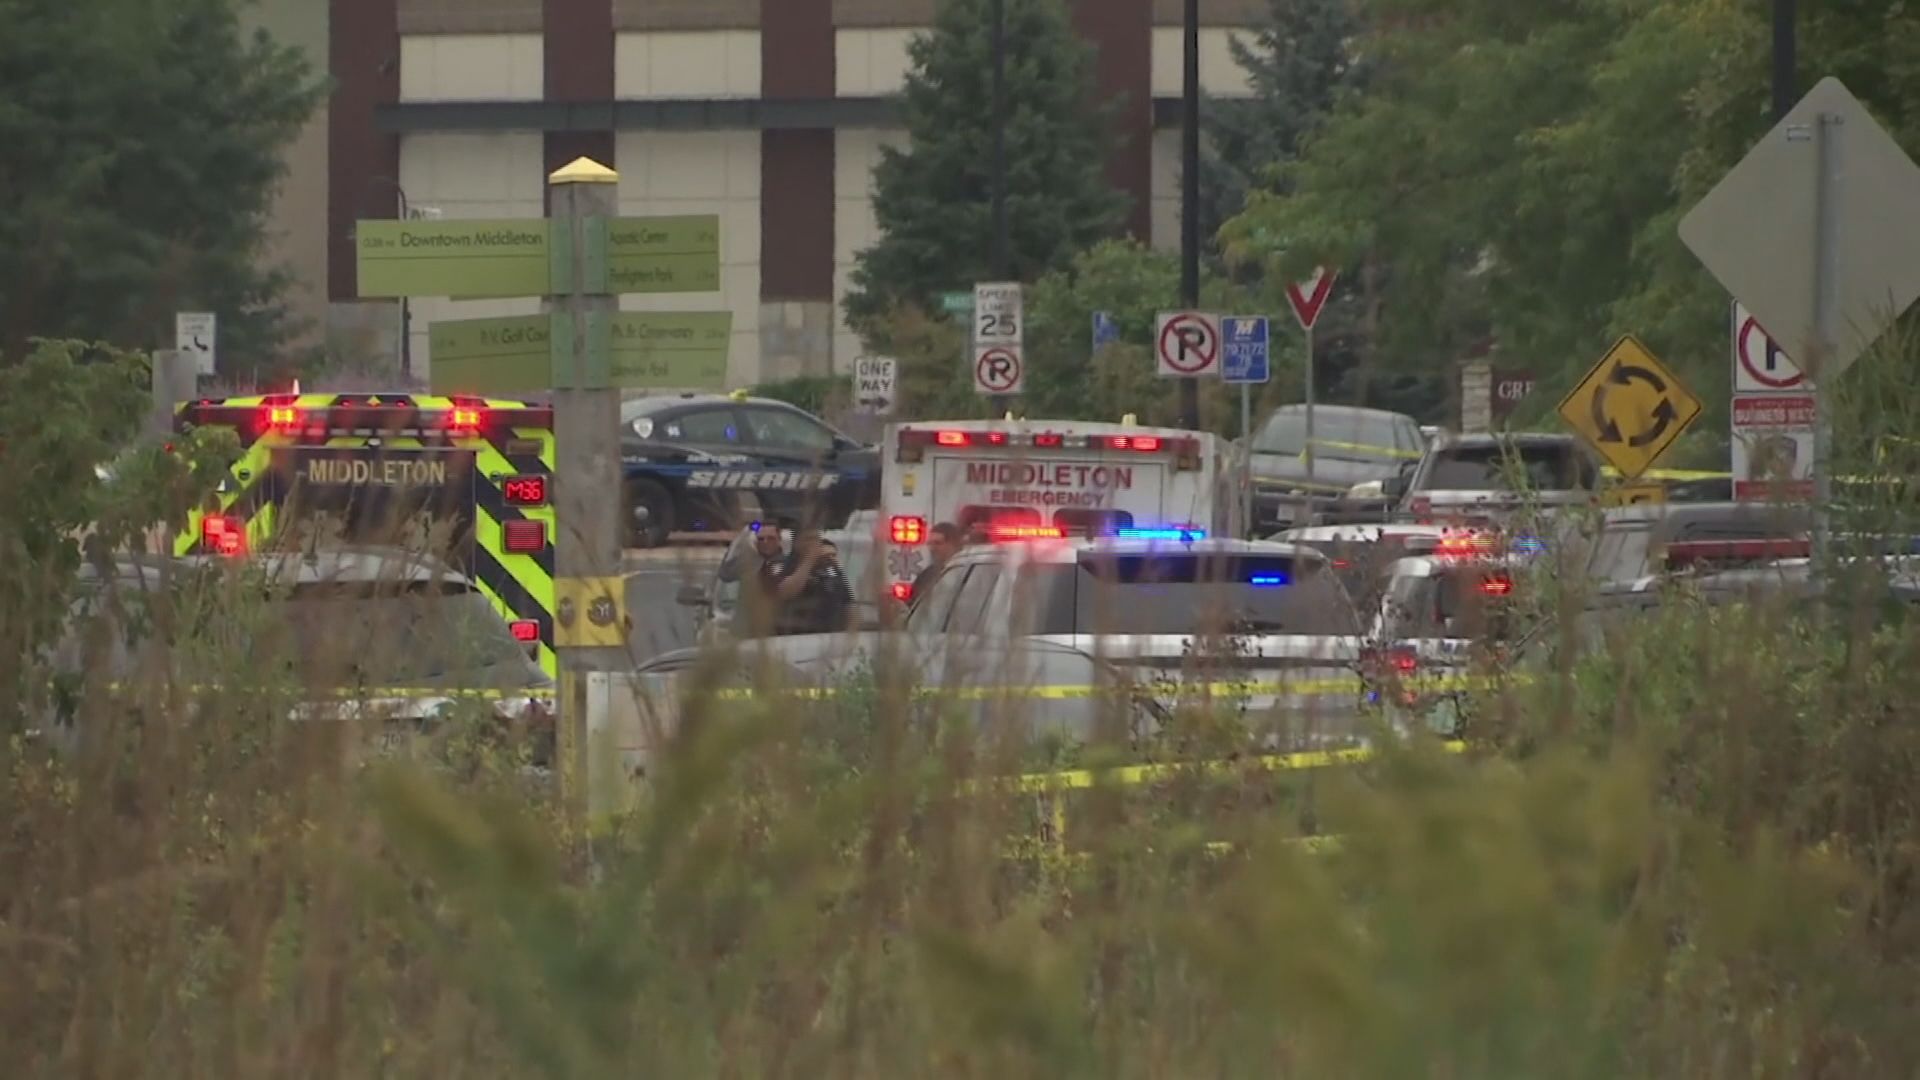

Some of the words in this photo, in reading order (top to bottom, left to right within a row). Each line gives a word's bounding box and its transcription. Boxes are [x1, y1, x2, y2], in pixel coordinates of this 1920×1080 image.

[401, 231, 472, 248] Downtown
[474, 229, 543, 247] Middleton
[980, 289, 1018, 300] SPEED
[981, 314, 1017, 336] 25
[502, 327, 525, 344] Golf
[1177, 325, 1206, 362] P
[860, 361, 891, 377] ONE
[988, 357, 1011, 382] P
[862, 378, 891, 392] WAY
[309, 459, 445, 484] MIDDLETON
[966, 462, 1133, 490] MIDDLETON
[506, 481, 541, 500] M36
[990, 489, 1105, 508] EMERGENCY
